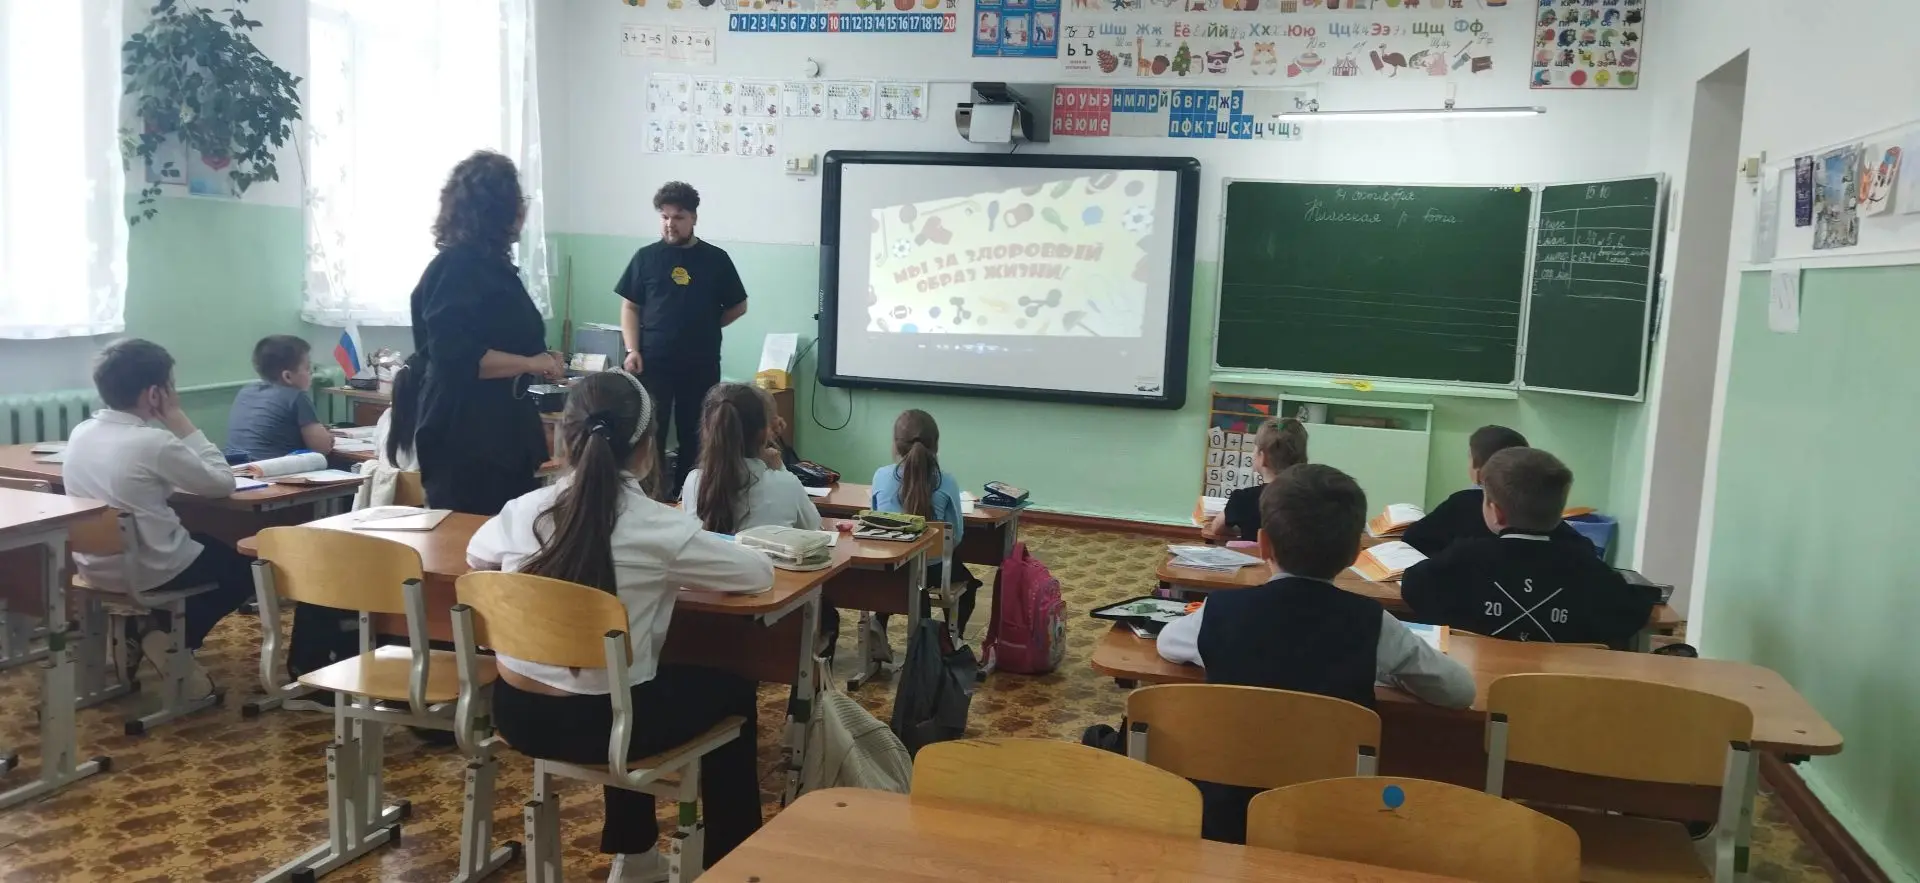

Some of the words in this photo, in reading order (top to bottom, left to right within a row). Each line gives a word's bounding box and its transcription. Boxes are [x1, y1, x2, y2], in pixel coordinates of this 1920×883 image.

[731, 16, 737, 29] 0
[742, 16, 747, 29] 1
[751, 16, 757, 29] 2
[760, 16, 767, 29] 3
[769, 16, 776, 29] 4
[780, 16, 787, 29] 5
[790, 16, 797, 29] 6
[800, 16, 807, 29] 7
[810, 16, 816, 29] 8
[820, 16, 826, 29] 9
[830, 16, 839, 29] 10
[840, 16, 849, 29] 11
[851, 16, 861, 29] 12
[863, 16, 873, 29] 13
[874, 16, 885, 29] 14
[886, 16, 896, 29] 15
[898, 16, 908, 29] 16
[909, 16, 919, 29] 17
[920, 16, 931, 29] 18
[932, 16, 943, 29] 19
[944, 16, 954, 29] 20
[1100, 22, 1126, 35] Шш
[1174, 21, 1191, 38] Ёё
[1207, 22, 1229, 38] Йй
[1287, 24, 1316, 37] Юю
[1329, 23, 1350, 37] Цц
[1371, 23, 1391, 36] Ээ
[1413, 22, 1445, 37] Щщ
[1454, 18, 1483, 36] Фф
[623, 33, 628, 42] 3
[640, 33, 646, 43] 2
[671, 35, 677, 45] 8
[686, 36, 692, 46] 2
[704, 37, 710, 46] 6
[893, 262, 928, 284] МЫ
[934, 253, 958, 270] ЗА
[965, 242, 1104, 263] ЗДОРОВЫЙ
[916, 268, 977, 293] ОБРАЗ
[984, 263, 1071, 281] ЖИЗНИ!
[1211, 453, 1218, 463] 1
[1227, 454, 1235, 466] 2
[1245, 456, 1253, 468] 3
[1210, 470, 1218, 481] 5
[1226, 470, 1234, 482] 9
[1242, 474, 1250, 486] 7
[1257, 474, 1264, 485] 8
[1524, 578, 1533, 593] S
[1484, 601, 1503, 617] 20
[1551, 608, 1568, 624] 06
